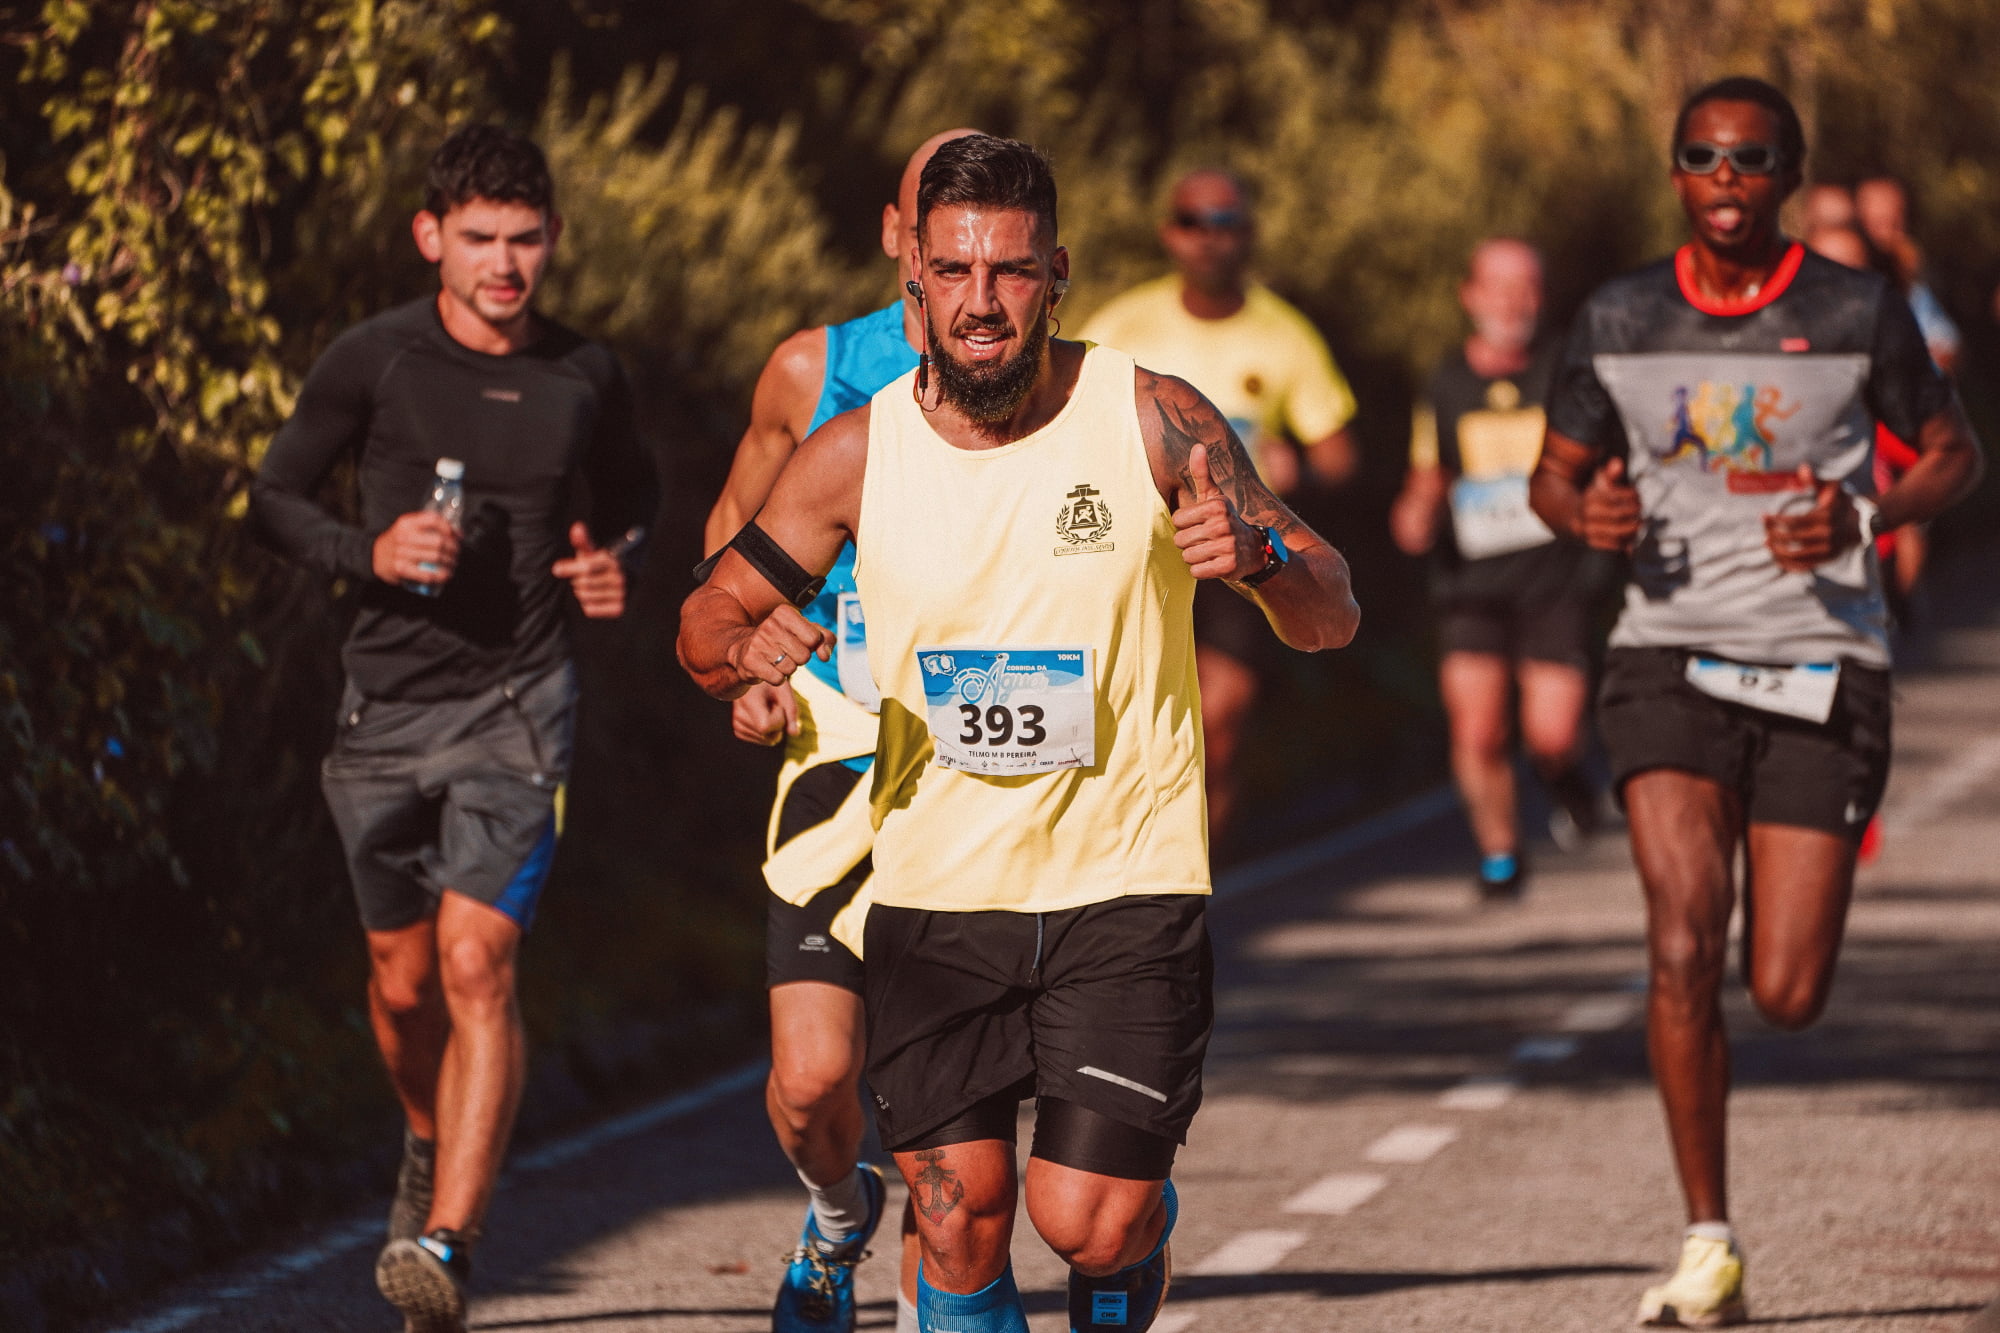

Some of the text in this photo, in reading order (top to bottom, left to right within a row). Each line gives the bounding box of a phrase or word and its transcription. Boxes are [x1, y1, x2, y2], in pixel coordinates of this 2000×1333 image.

[1057, 653, 1080, 661] 10KM
[1036, 664, 1047, 672] DA
[958, 703, 1046, 746] 393
[968, 750, 990, 758] TELMO
[1006, 750, 1037, 759] PEREIRA
